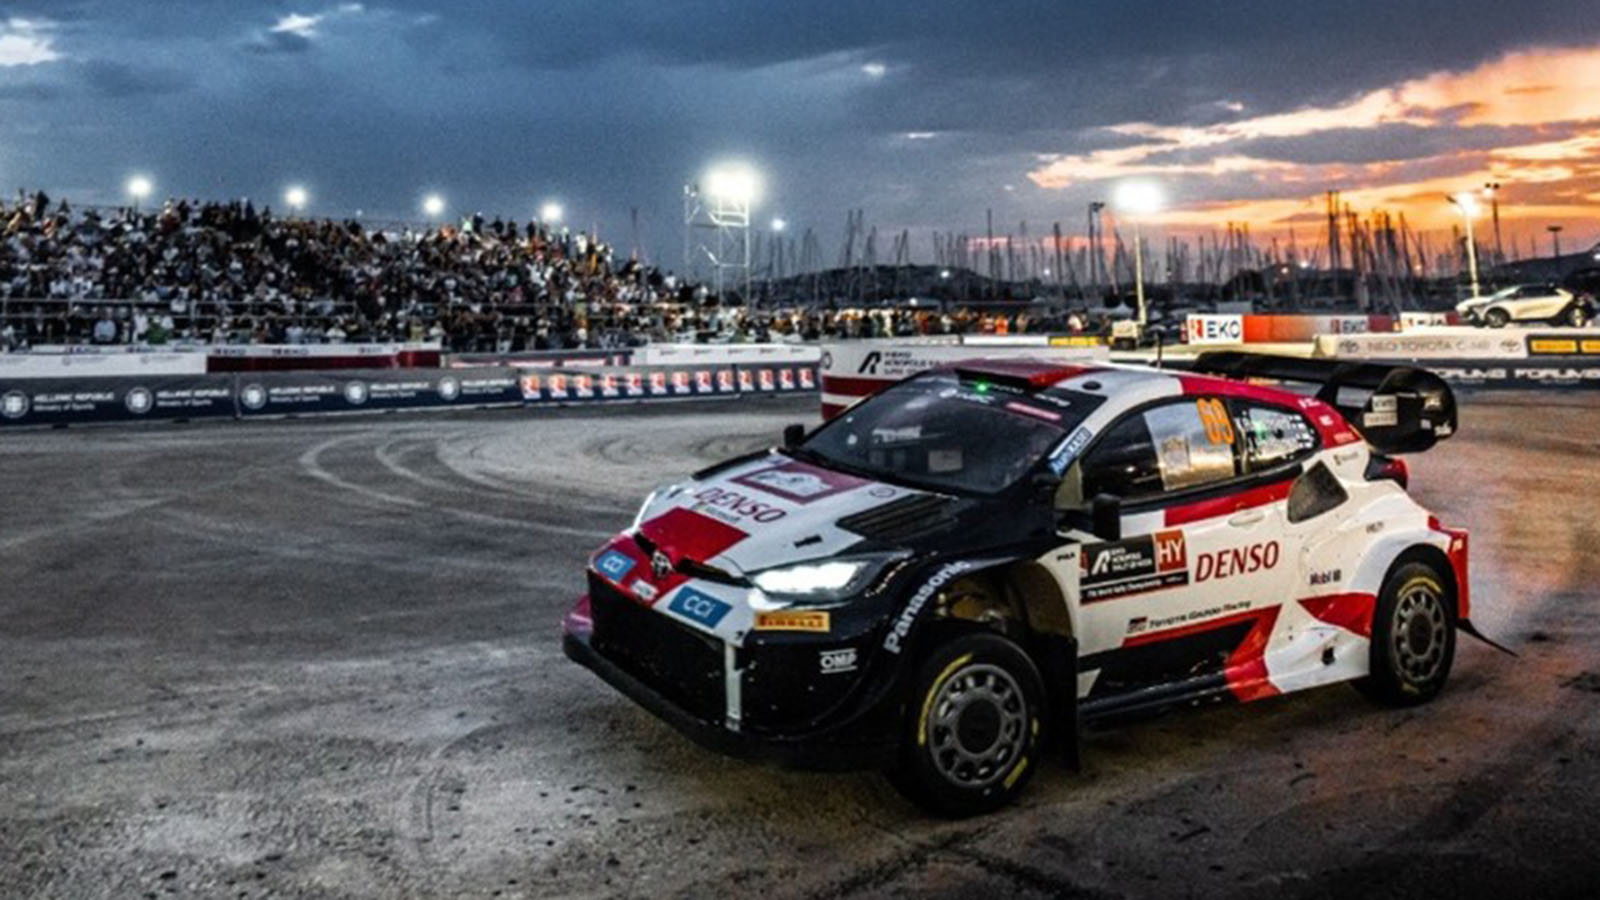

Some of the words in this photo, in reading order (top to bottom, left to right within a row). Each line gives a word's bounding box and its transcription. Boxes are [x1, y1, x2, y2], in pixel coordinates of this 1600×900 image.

[1207, 321, 1241, 339] EKO
[694, 486, 788, 523] DENSO
[1159, 539, 1184, 564] HY
[1194, 540, 1280, 583] DENSO
[883, 561, 971, 655] Panasonic
[820, 652, 858, 670] OMP
